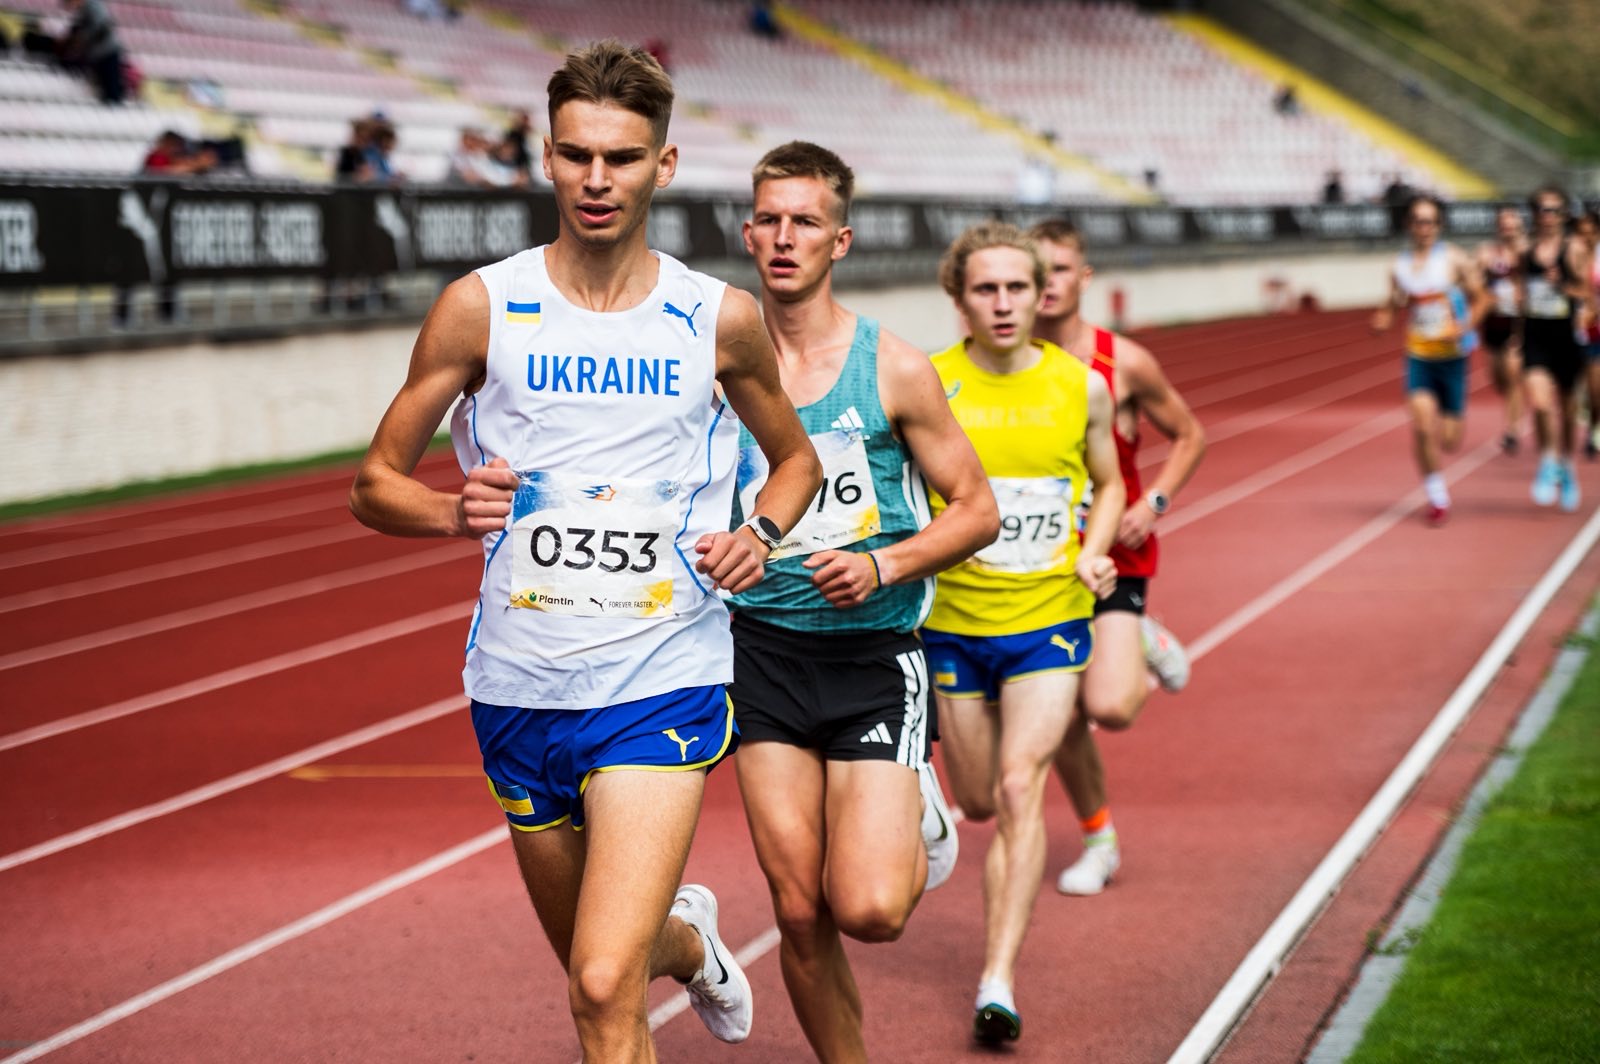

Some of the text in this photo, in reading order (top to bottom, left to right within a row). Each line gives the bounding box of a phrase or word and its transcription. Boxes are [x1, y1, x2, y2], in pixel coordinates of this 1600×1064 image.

[527, 354, 681, 396] UKRAINE
[1000, 511, 1063, 542] 975
[530, 525, 660, 573] 0353
[539, 594, 574, 606] Plantin
